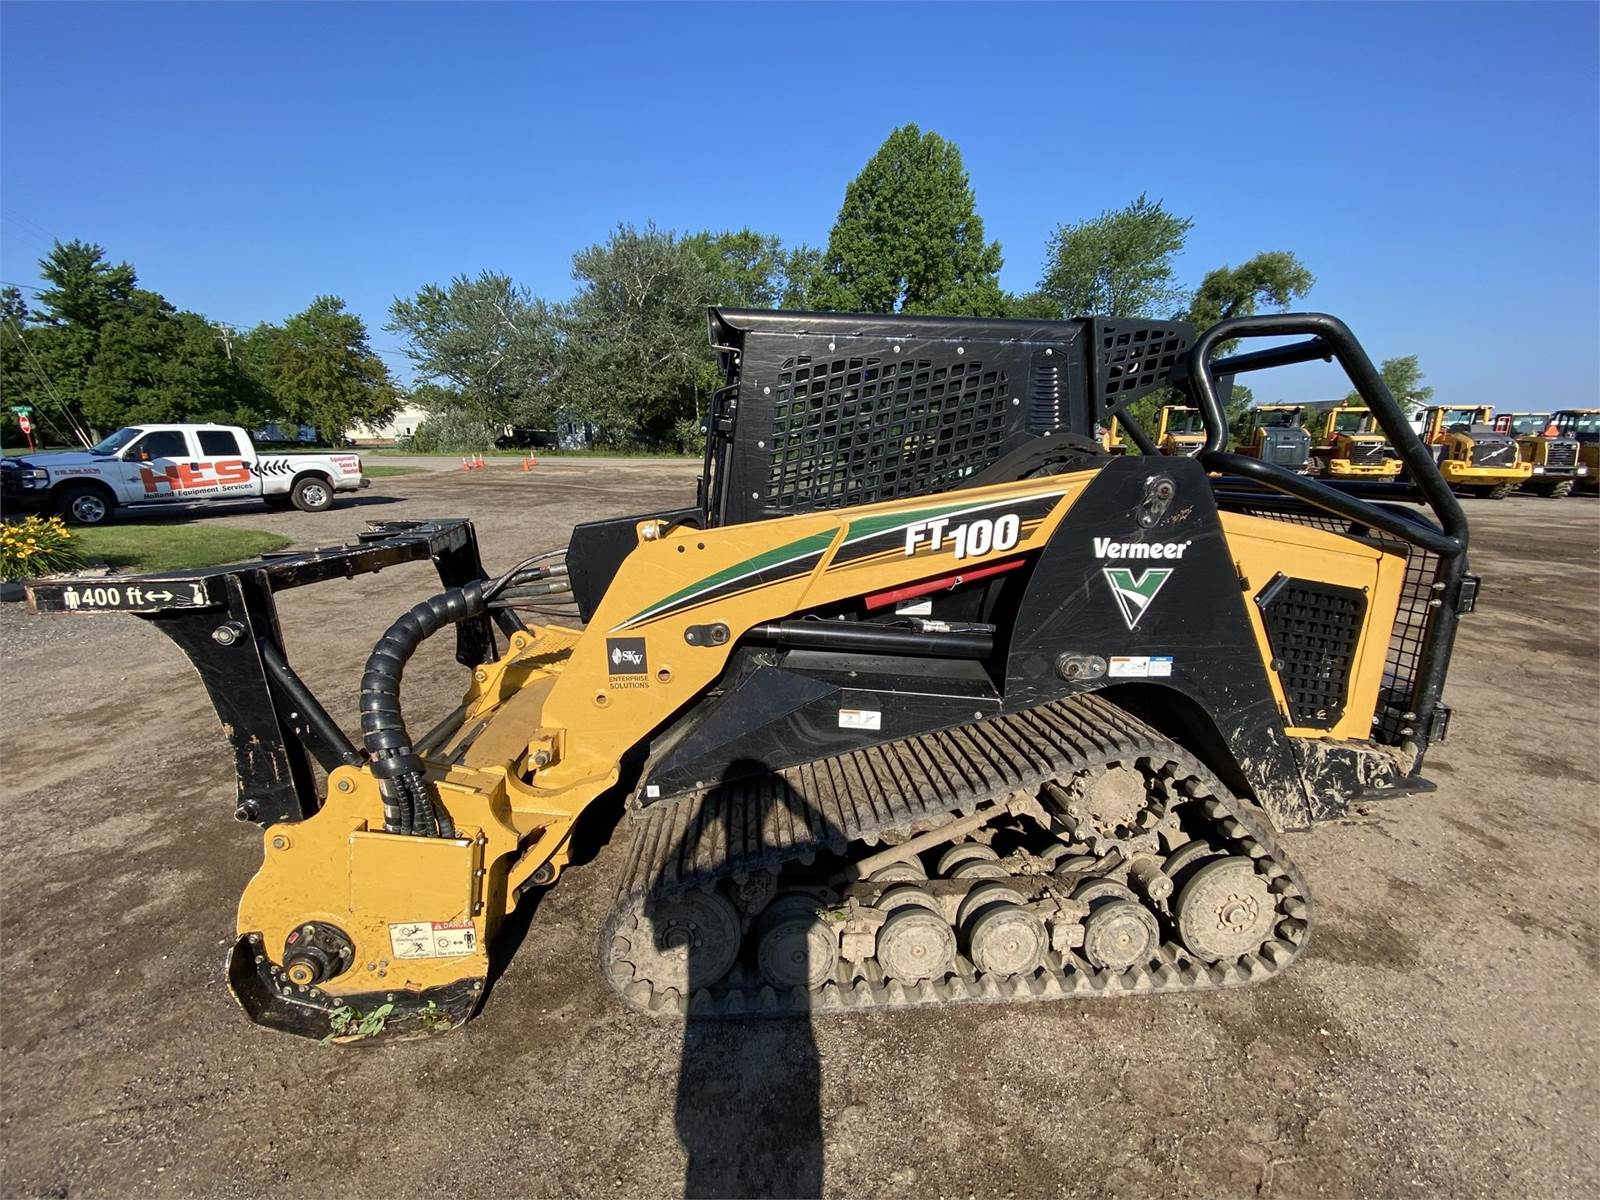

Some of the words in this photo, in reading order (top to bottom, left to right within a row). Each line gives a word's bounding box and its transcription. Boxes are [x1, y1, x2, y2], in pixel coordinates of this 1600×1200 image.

[140, 460, 251, 493] HES
[144, 492, 175, 500] Holland
[178, 487, 219, 497] Equipment
[222, 483, 253, 493] Services
[1093, 537, 1188, 559] Vermeer
[82, 588, 119, 606] 400
[126, 587, 145, 605] ft
